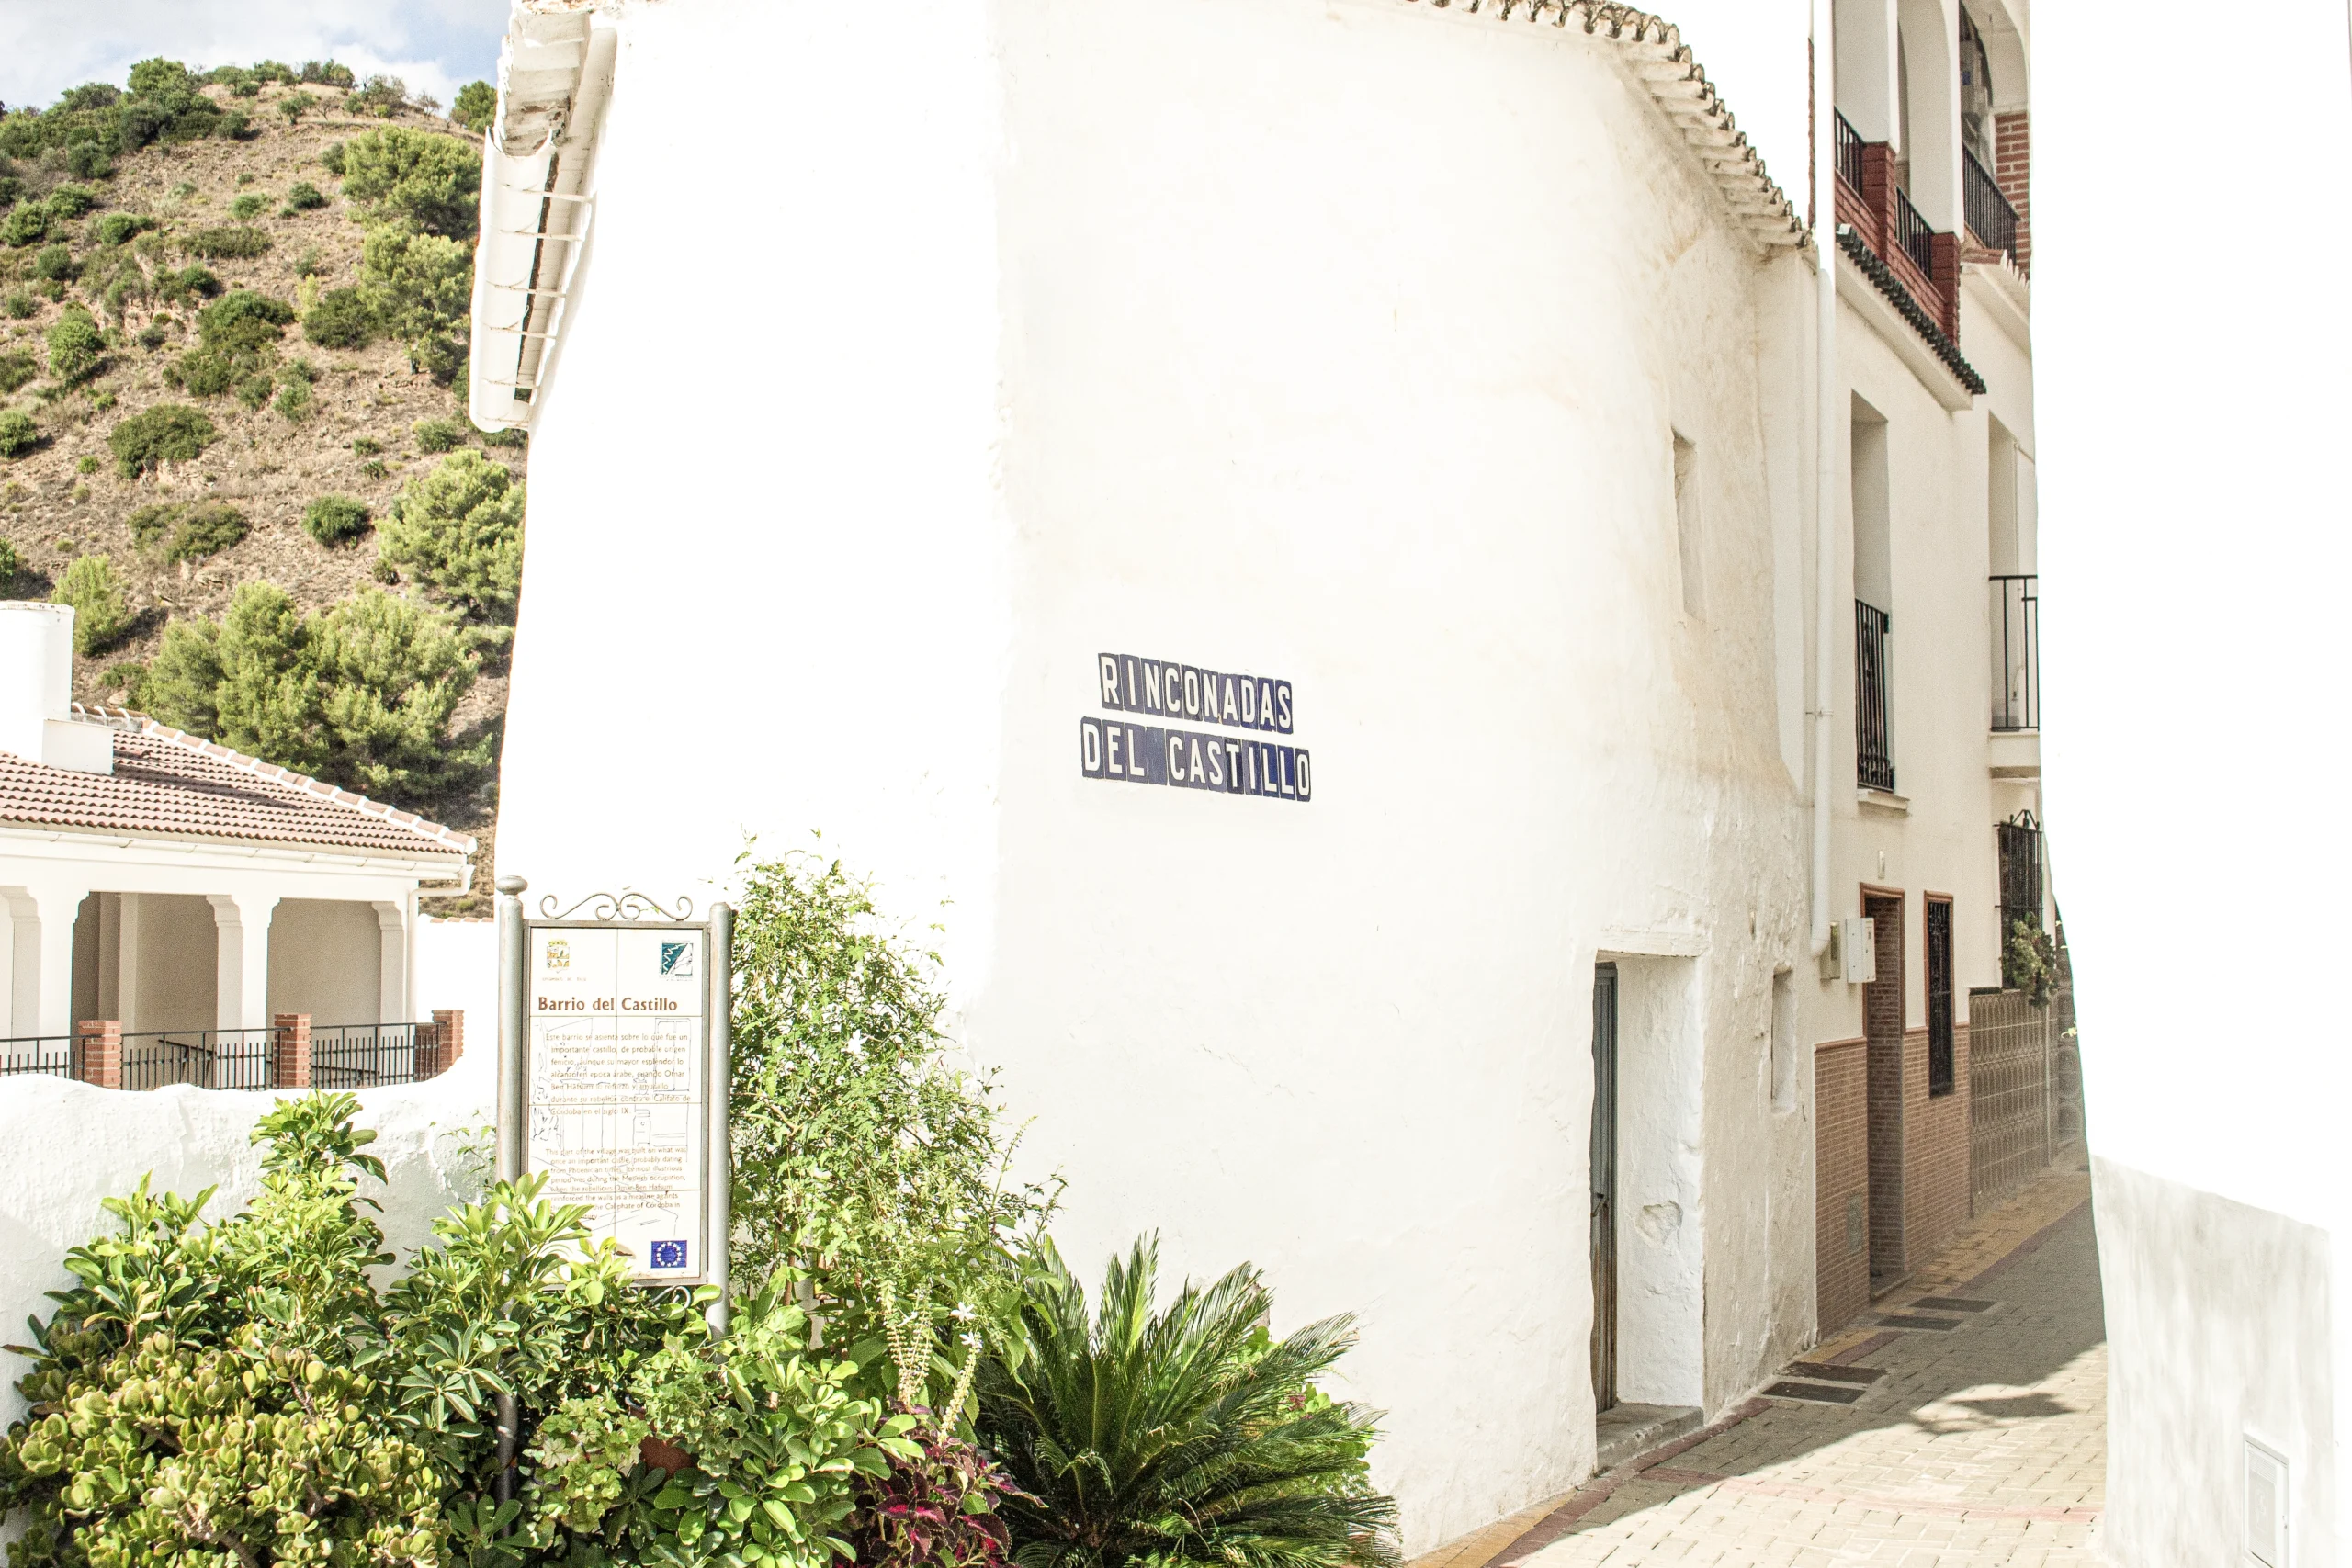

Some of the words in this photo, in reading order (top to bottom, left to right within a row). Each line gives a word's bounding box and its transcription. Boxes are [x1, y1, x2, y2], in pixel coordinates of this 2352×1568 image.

[1100, 655, 1292, 729] RINCONADAS
[1082, 723, 1146, 777] DEL
[1169, 736, 1310, 796] CASTILLO
[538, 997, 585, 1010] Barrio
[593, 998, 615, 1010] del
[621, 997, 678, 1010] Castillo
